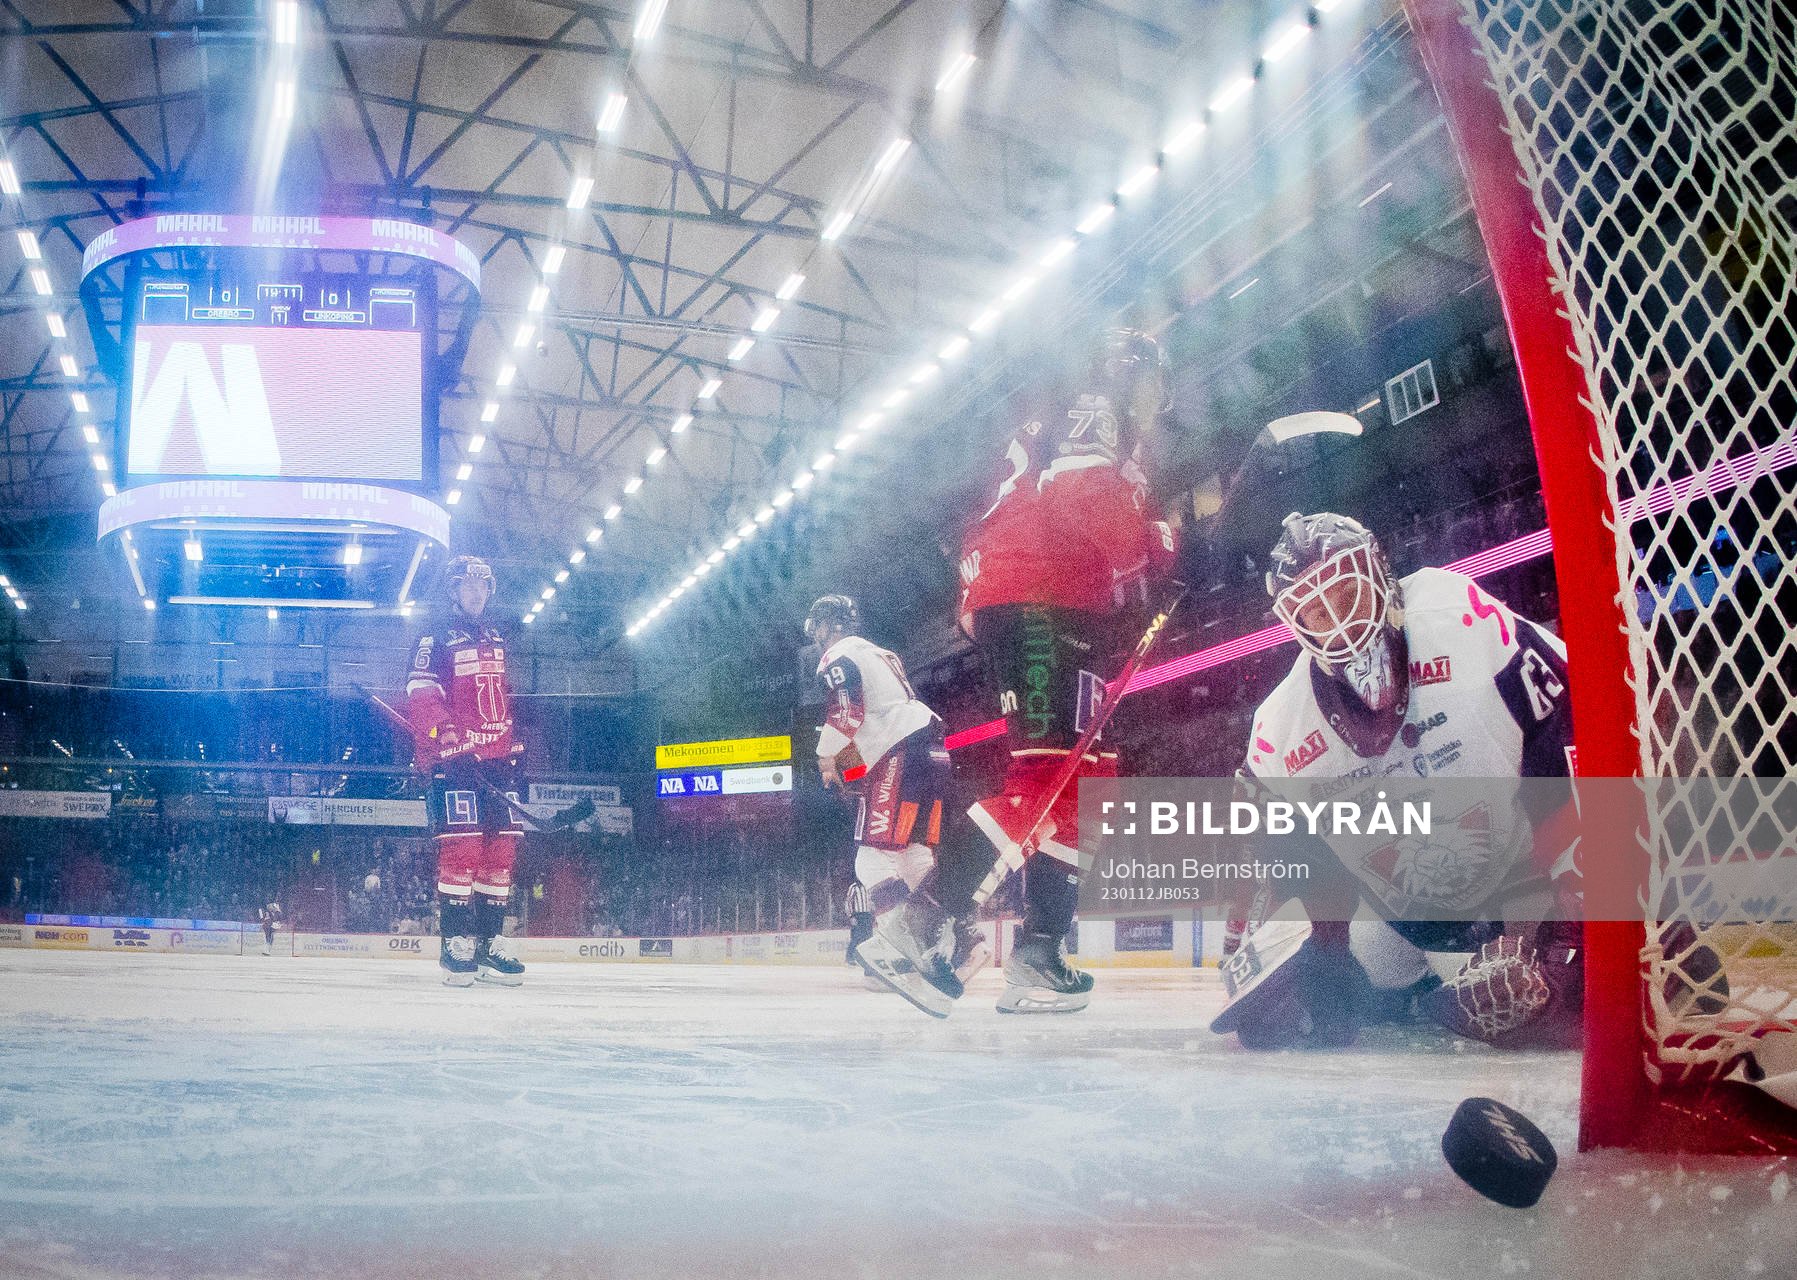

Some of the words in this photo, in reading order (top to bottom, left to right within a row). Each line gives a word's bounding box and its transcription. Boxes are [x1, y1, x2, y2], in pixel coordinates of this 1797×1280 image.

[824, 666, 846, 690] 19
[1409, 658, 1452, 684] MAXI
[664, 743, 735, 759] Mekonomen
[1284, 730, 1328, 774] MAXI
[660, 777, 686, 794] NA
[693, 775, 719, 792] NA
[388, 938, 422, 949] OBK
